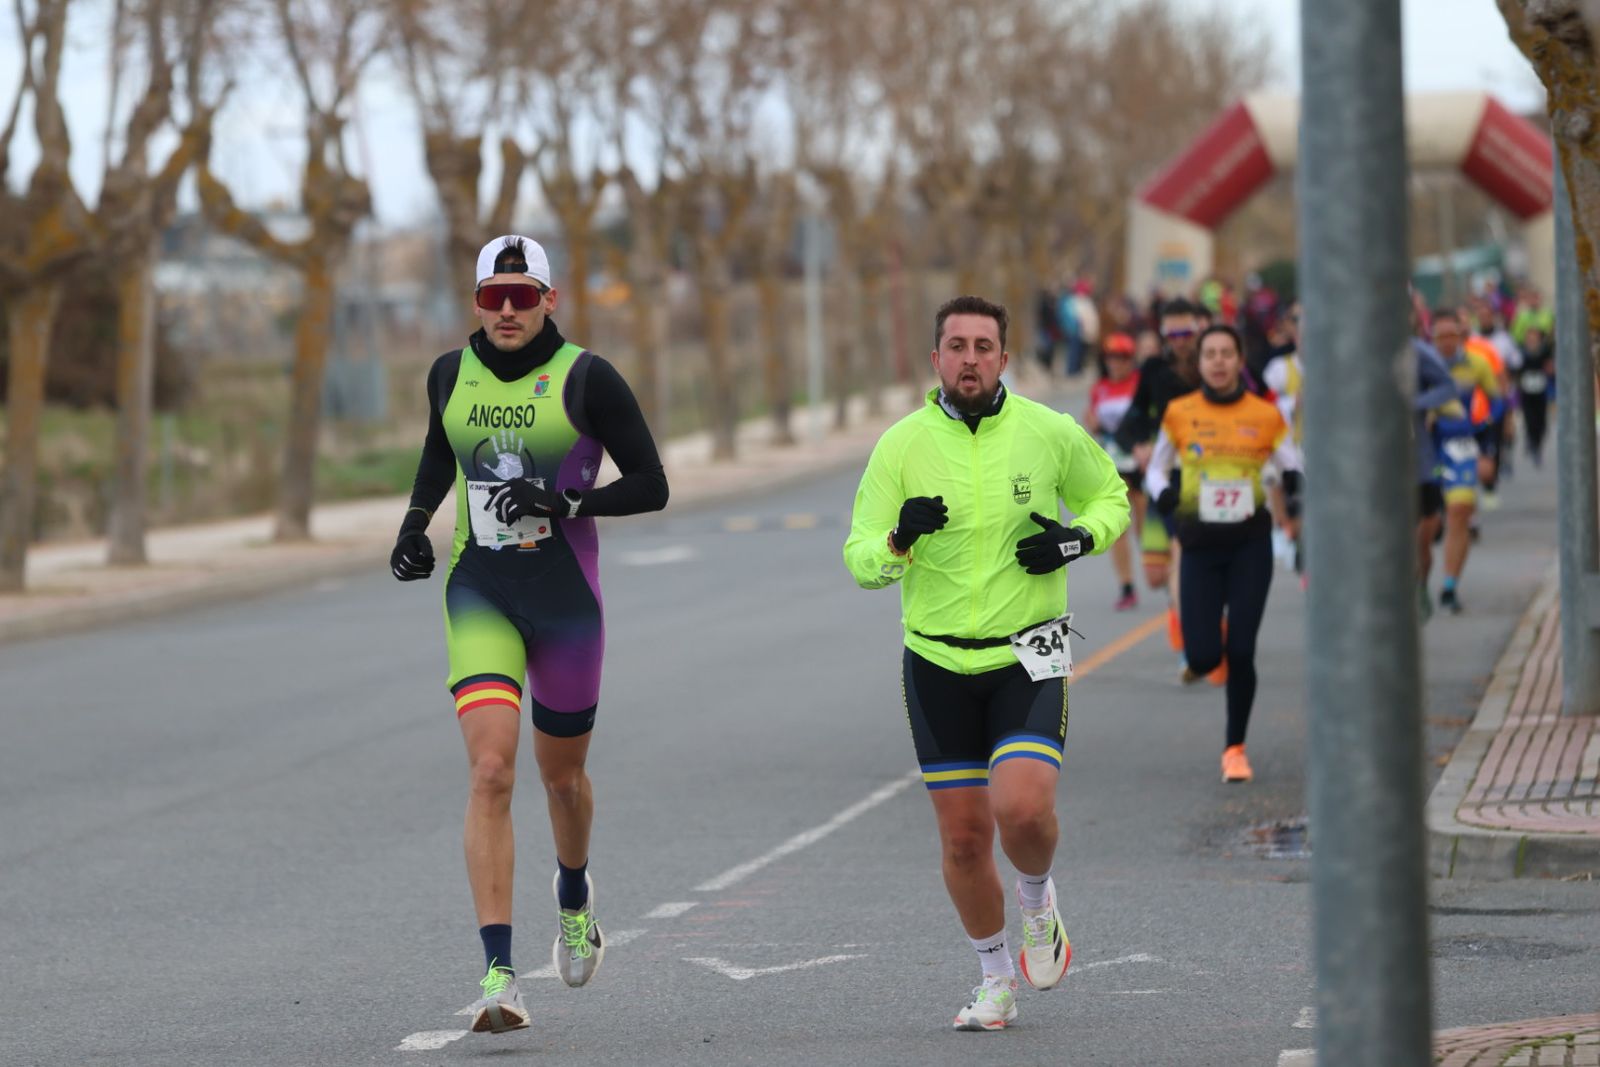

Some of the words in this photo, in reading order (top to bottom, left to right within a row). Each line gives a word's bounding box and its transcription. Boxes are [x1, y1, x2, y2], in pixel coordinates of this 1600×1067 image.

[466, 403, 536, 429] ANGOSO
[1213, 488, 1242, 508] 27
[1026, 630, 1065, 657] 34
